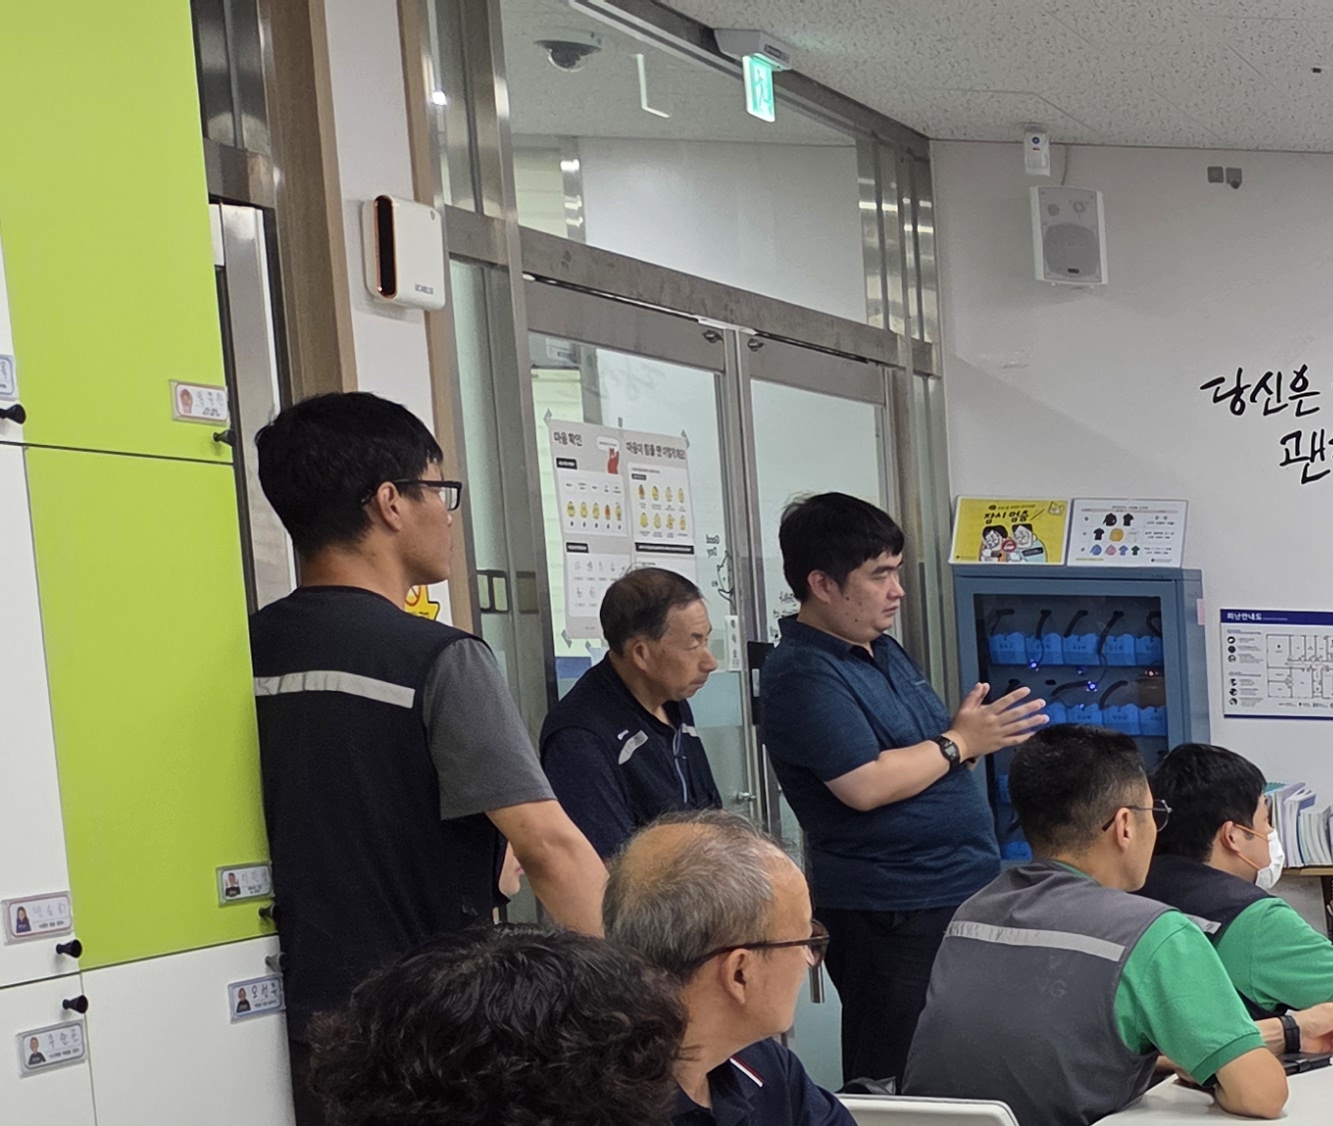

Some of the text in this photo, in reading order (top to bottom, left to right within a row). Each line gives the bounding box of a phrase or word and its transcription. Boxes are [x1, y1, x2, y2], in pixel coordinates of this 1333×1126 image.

[1200, 363, 1321, 417] 당신은
[983, 511, 1007, 525] 잠시
[1226, 612, 1263, 621] 피난안내도
